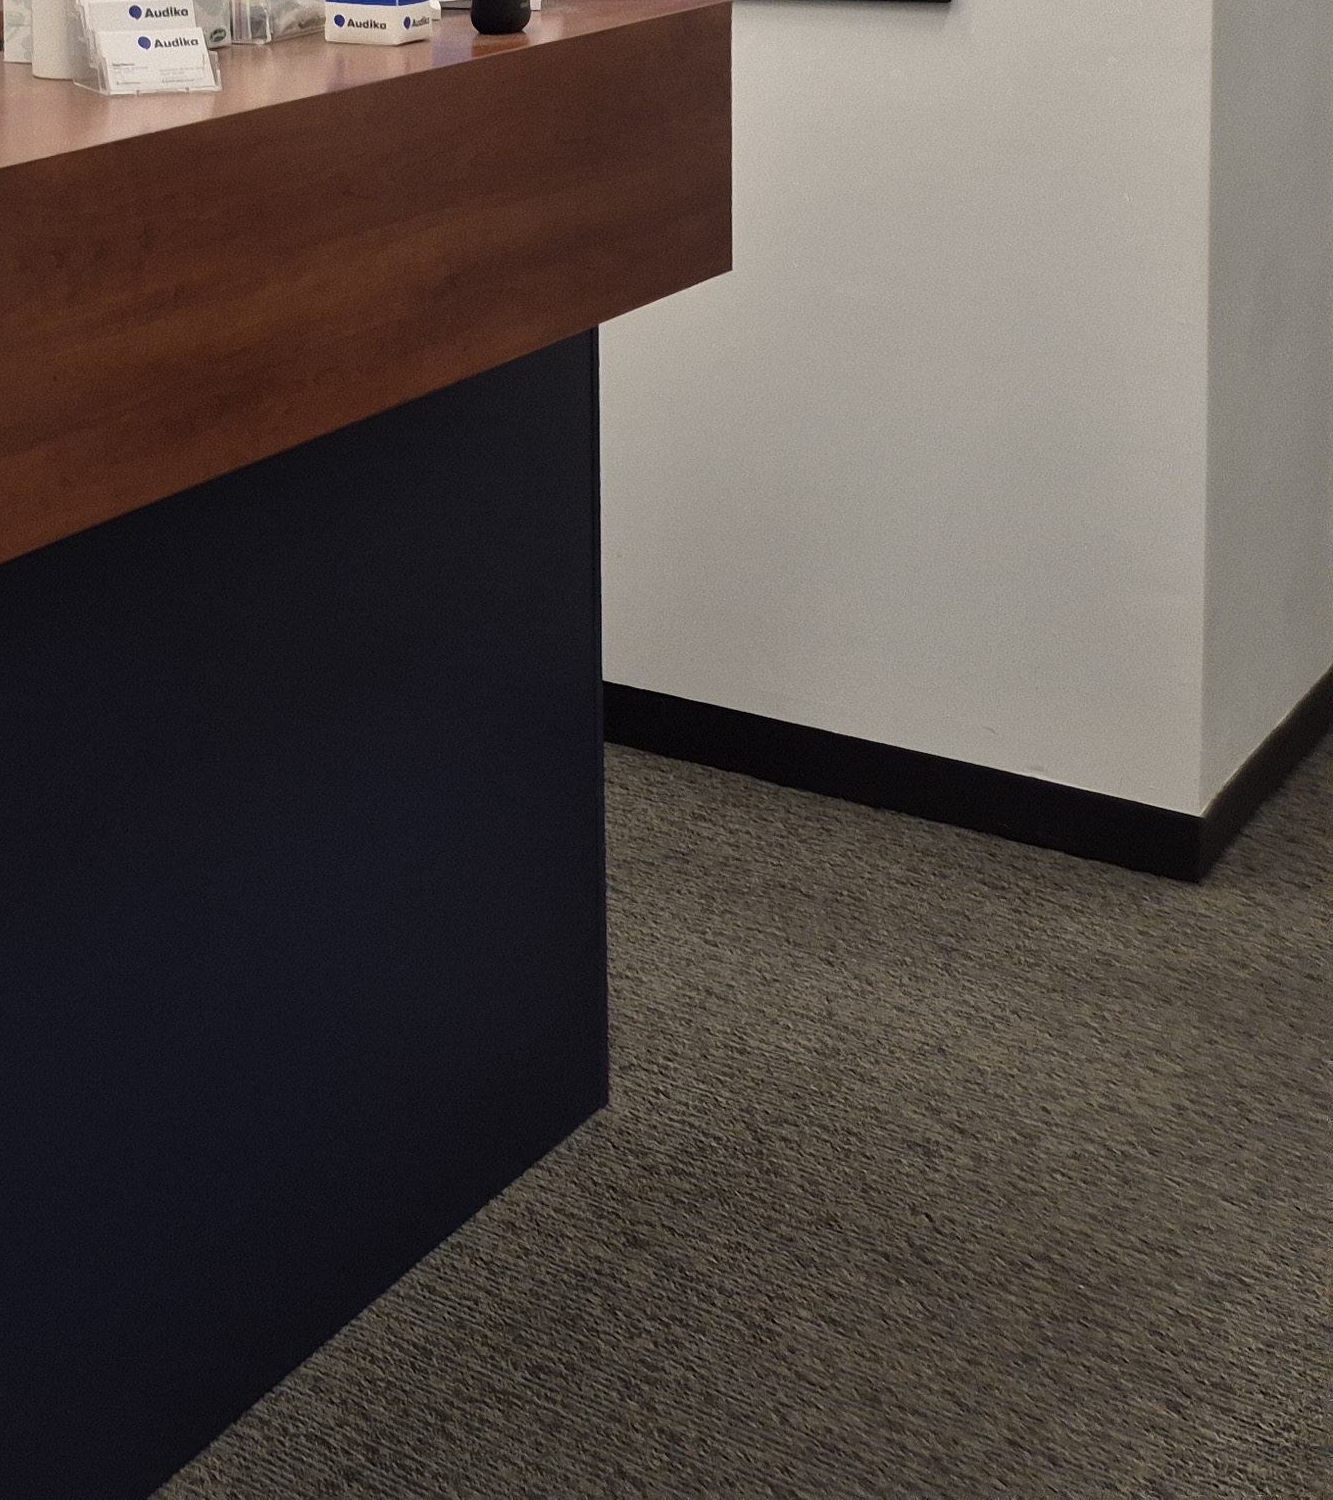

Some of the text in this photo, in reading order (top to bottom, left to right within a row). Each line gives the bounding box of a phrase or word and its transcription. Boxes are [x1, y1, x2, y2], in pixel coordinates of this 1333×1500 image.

[144, 7, 189, 18] Audika
[347, 18, 387, 29] Audika
[154, 37, 199, 49] Audika
